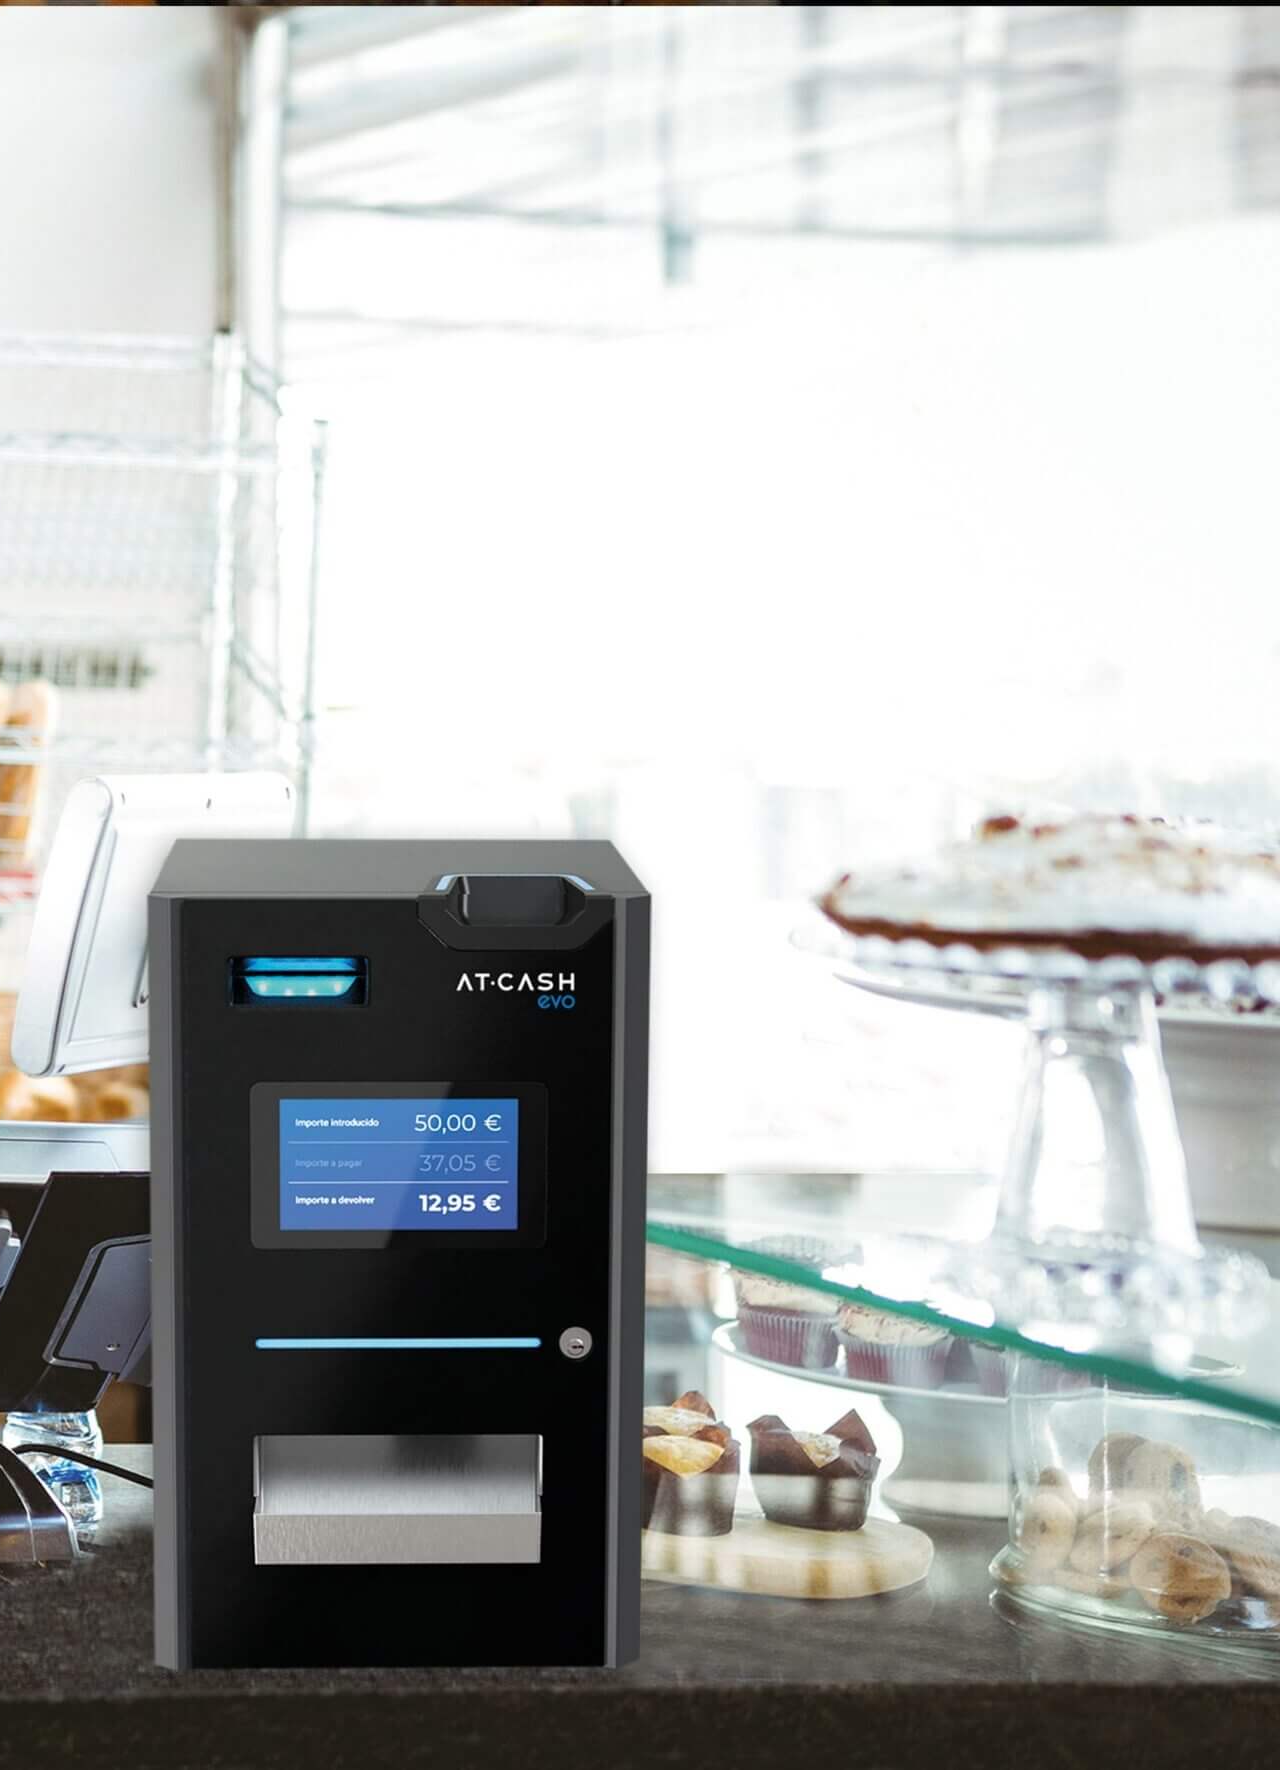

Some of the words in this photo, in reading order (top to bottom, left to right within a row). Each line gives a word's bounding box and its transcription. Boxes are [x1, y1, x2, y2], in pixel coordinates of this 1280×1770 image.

[537, 994, 576, 1009] evo
[295, 1118, 329, 1128] Importe
[330, 1118, 380, 1127] introducido
[414, 1113, 476, 1135] 50,00
[483, 1113, 502, 1132] €
[295, 1159, 329, 1168] Importe
[419, 1154, 476, 1175] 37,05
[485, 1154, 502, 1172] €
[295, 1196, 329, 1206] Importe
[331, 1197, 337, 1205] a
[338, 1195, 375, 1205] devolver
[418, 1194, 476, 1215] 12,95
[482, 1194, 502, 1212] €
